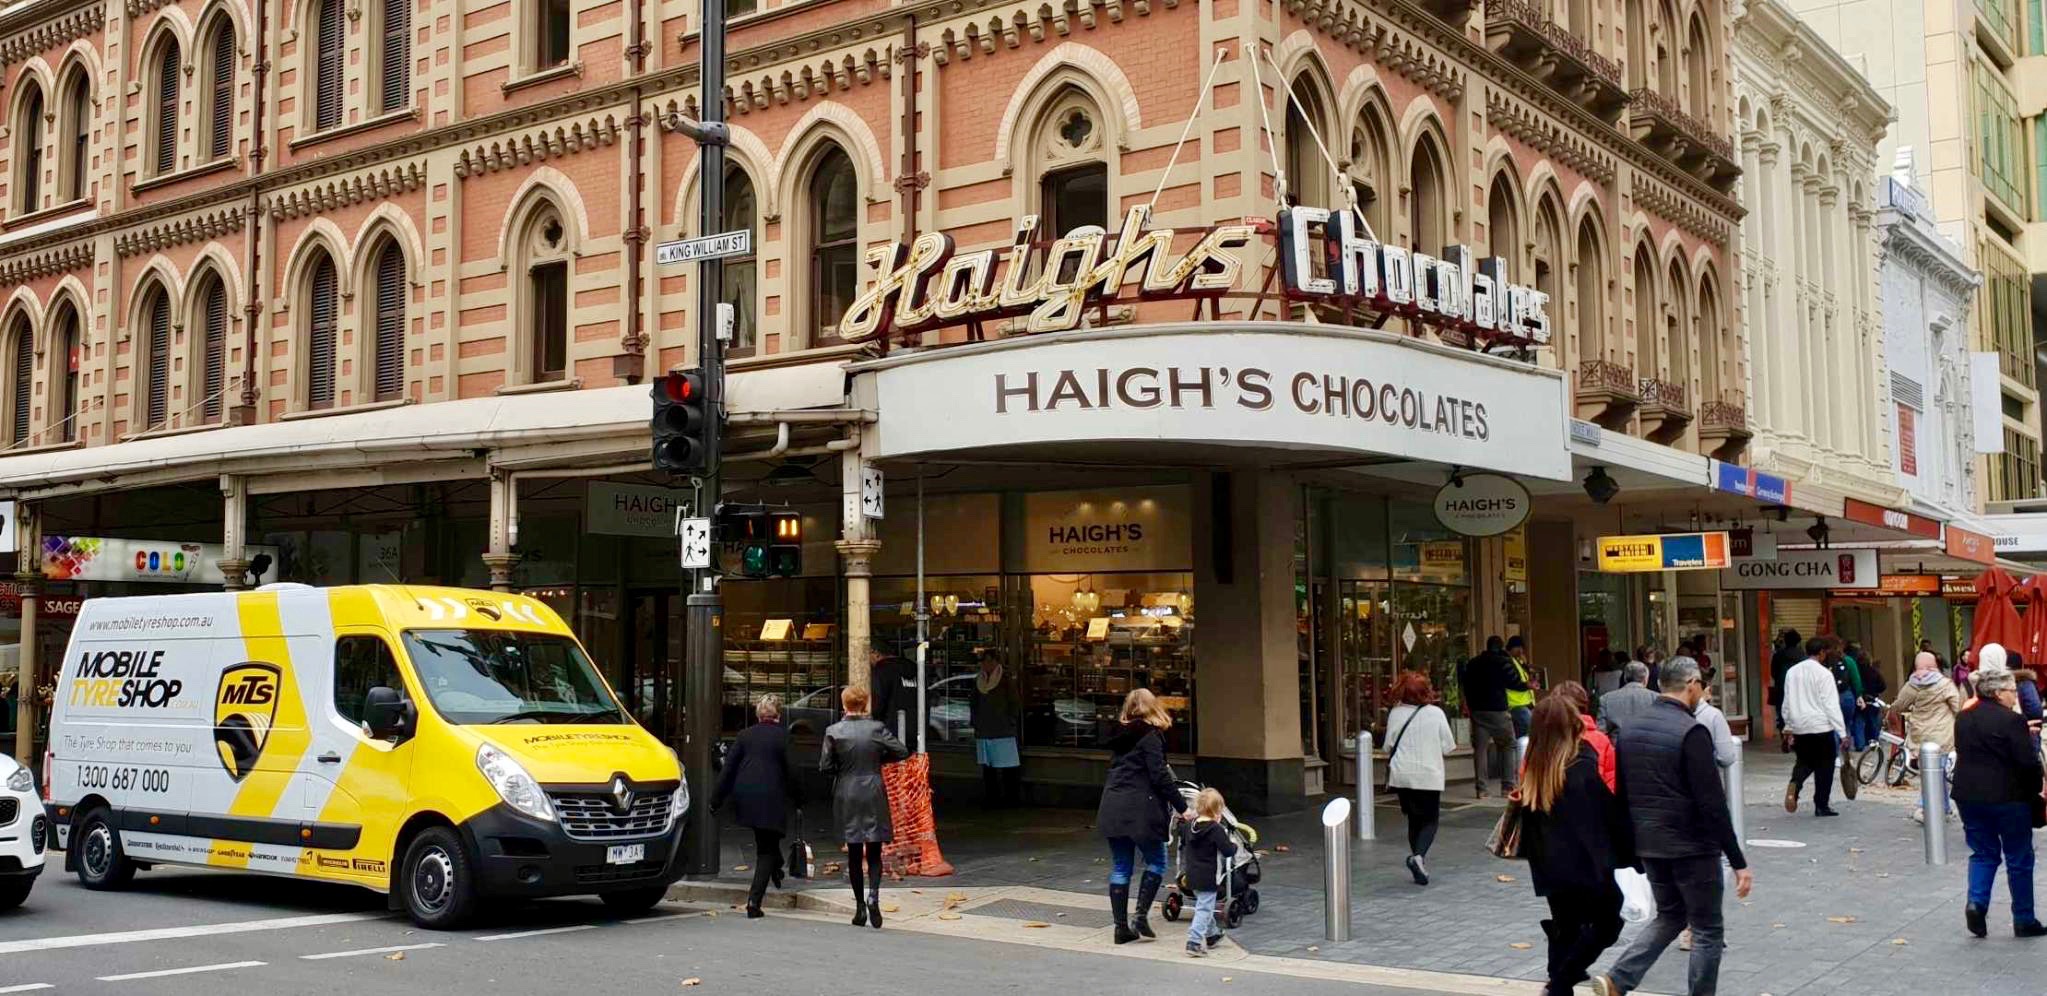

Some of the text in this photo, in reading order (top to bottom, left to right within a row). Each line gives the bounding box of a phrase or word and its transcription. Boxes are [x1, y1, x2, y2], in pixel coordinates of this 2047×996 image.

[669, 245, 691, 260] KING
[693, 238, 729, 256] WILLIAM
[732, 235, 743, 250] ST
[839, 204, 1551, 344] Haighs Chocolates
[994, 366, 1490, 441] HAIGH'S CHOCOLATES
[1446, 498, 1516, 511] HAIGH'S
[1049, 523, 1143, 544] HAIGH'S
[1063, 546, 1129, 555] CHOCOLATES
[1738, 561, 1790, 578] GONG
[1794, 561, 1832, 577] CHA
[45, 600, 80, 614] SAGE
[90, 616, 213, 631] www.mobiletyreshop.com.au
[76, 651, 165, 678] MOBILE
[70, 679, 182, 708] TYRESHOP
[221, 675, 275, 705] MTS
[64, 735, 192, 758] The Tyre Shop that comes to you
[77, 765, 169, 793] 1300 687 000
[352, 858, 386, 873] PIRELLI
